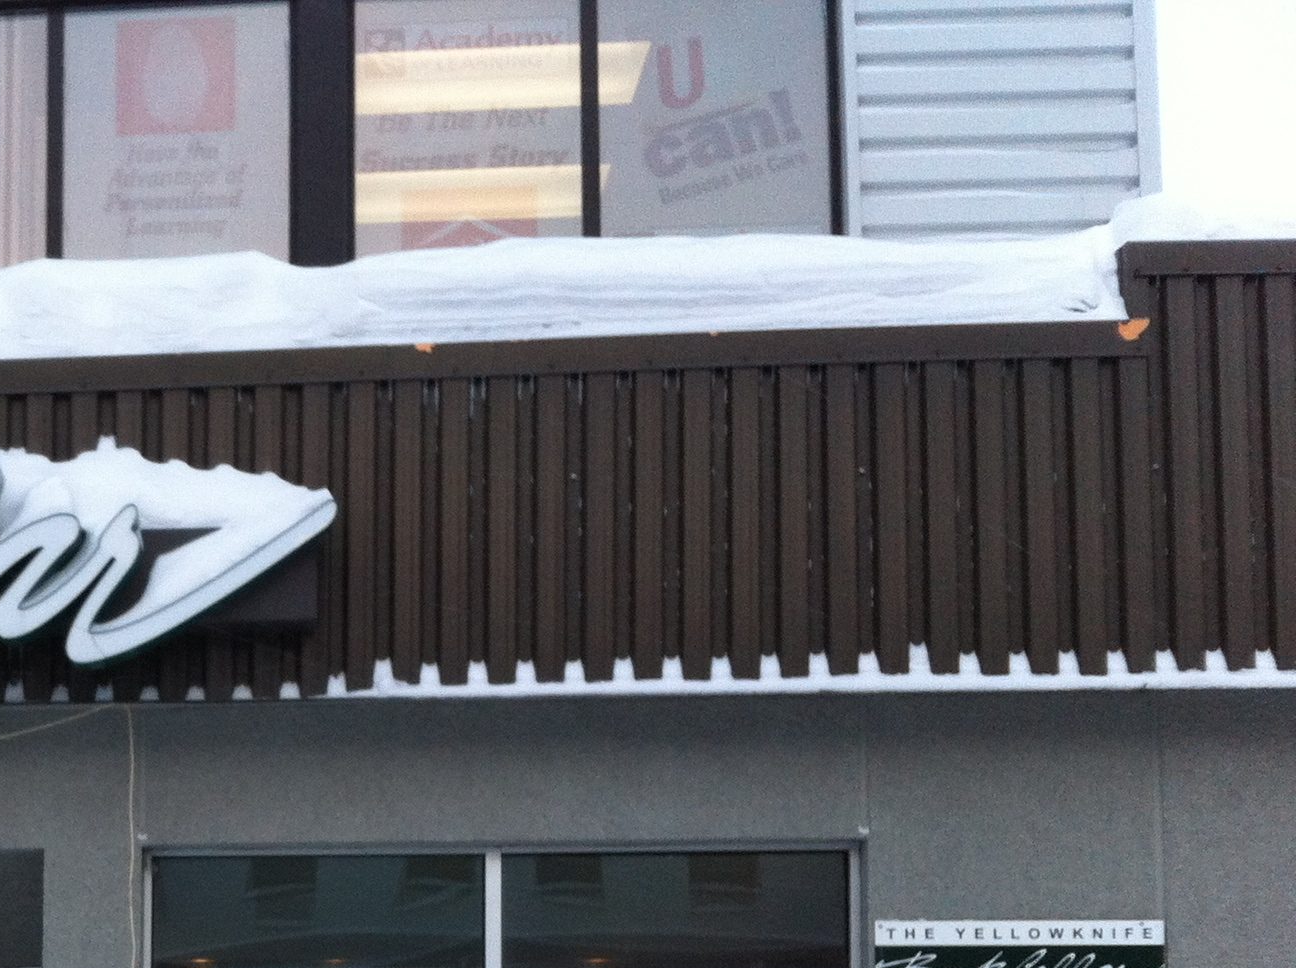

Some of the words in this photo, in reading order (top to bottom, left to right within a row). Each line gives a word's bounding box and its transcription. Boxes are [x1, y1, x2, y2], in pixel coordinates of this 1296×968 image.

[416, 22, 564, 50] Academy
[657, 35, 705, 109] U
[644, 86, 803, 178] can!
[887, 927, 936, 940] THE
[955, 927, 1155, 940] YELLOWKNIFE
